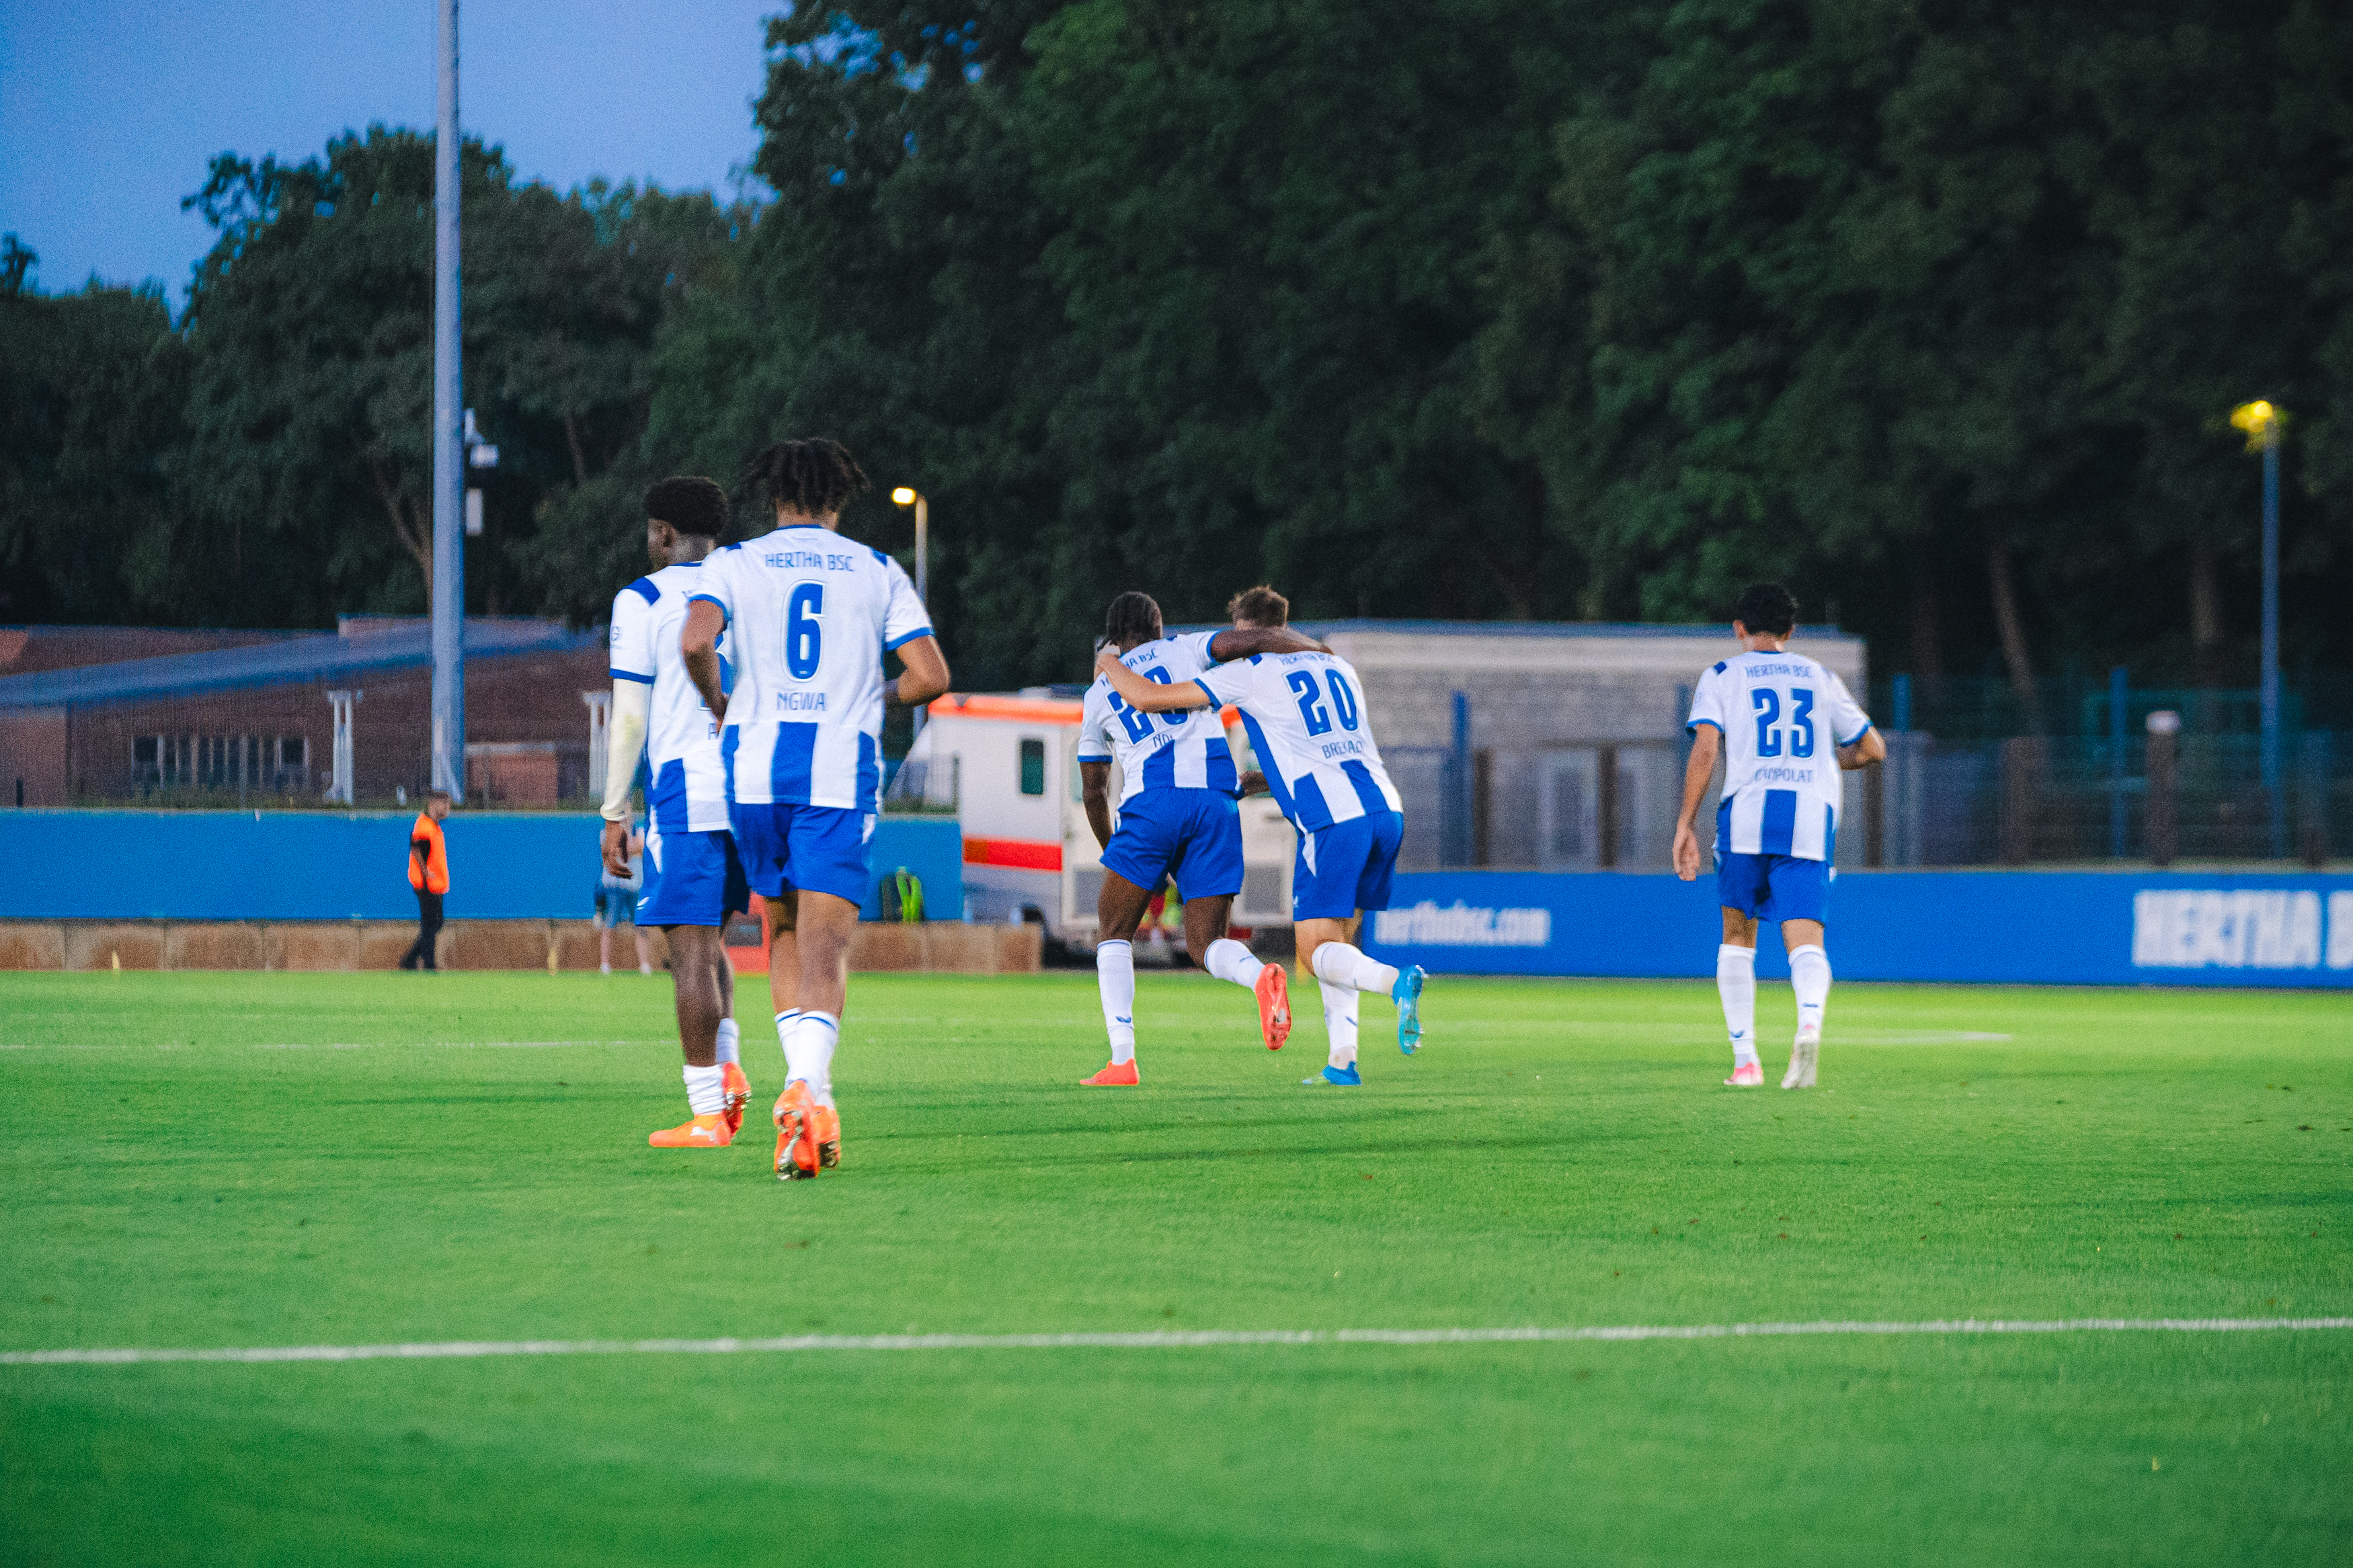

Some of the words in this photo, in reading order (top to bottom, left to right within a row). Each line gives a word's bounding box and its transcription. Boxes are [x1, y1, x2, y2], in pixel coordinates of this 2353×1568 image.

[765, 551, 822, 569] HERTHA
[826, 554, 854, 571] BSC
[785, 581, 826, 680] 6
[1138, 647, 1158, 663] BSC
[1745, 664, 1790, 678] HERTHA
[776, 692, 826, 711] NGWA
[1285, 667, 1359, 737] 20
[1751, 688, 1815, 758] 23
